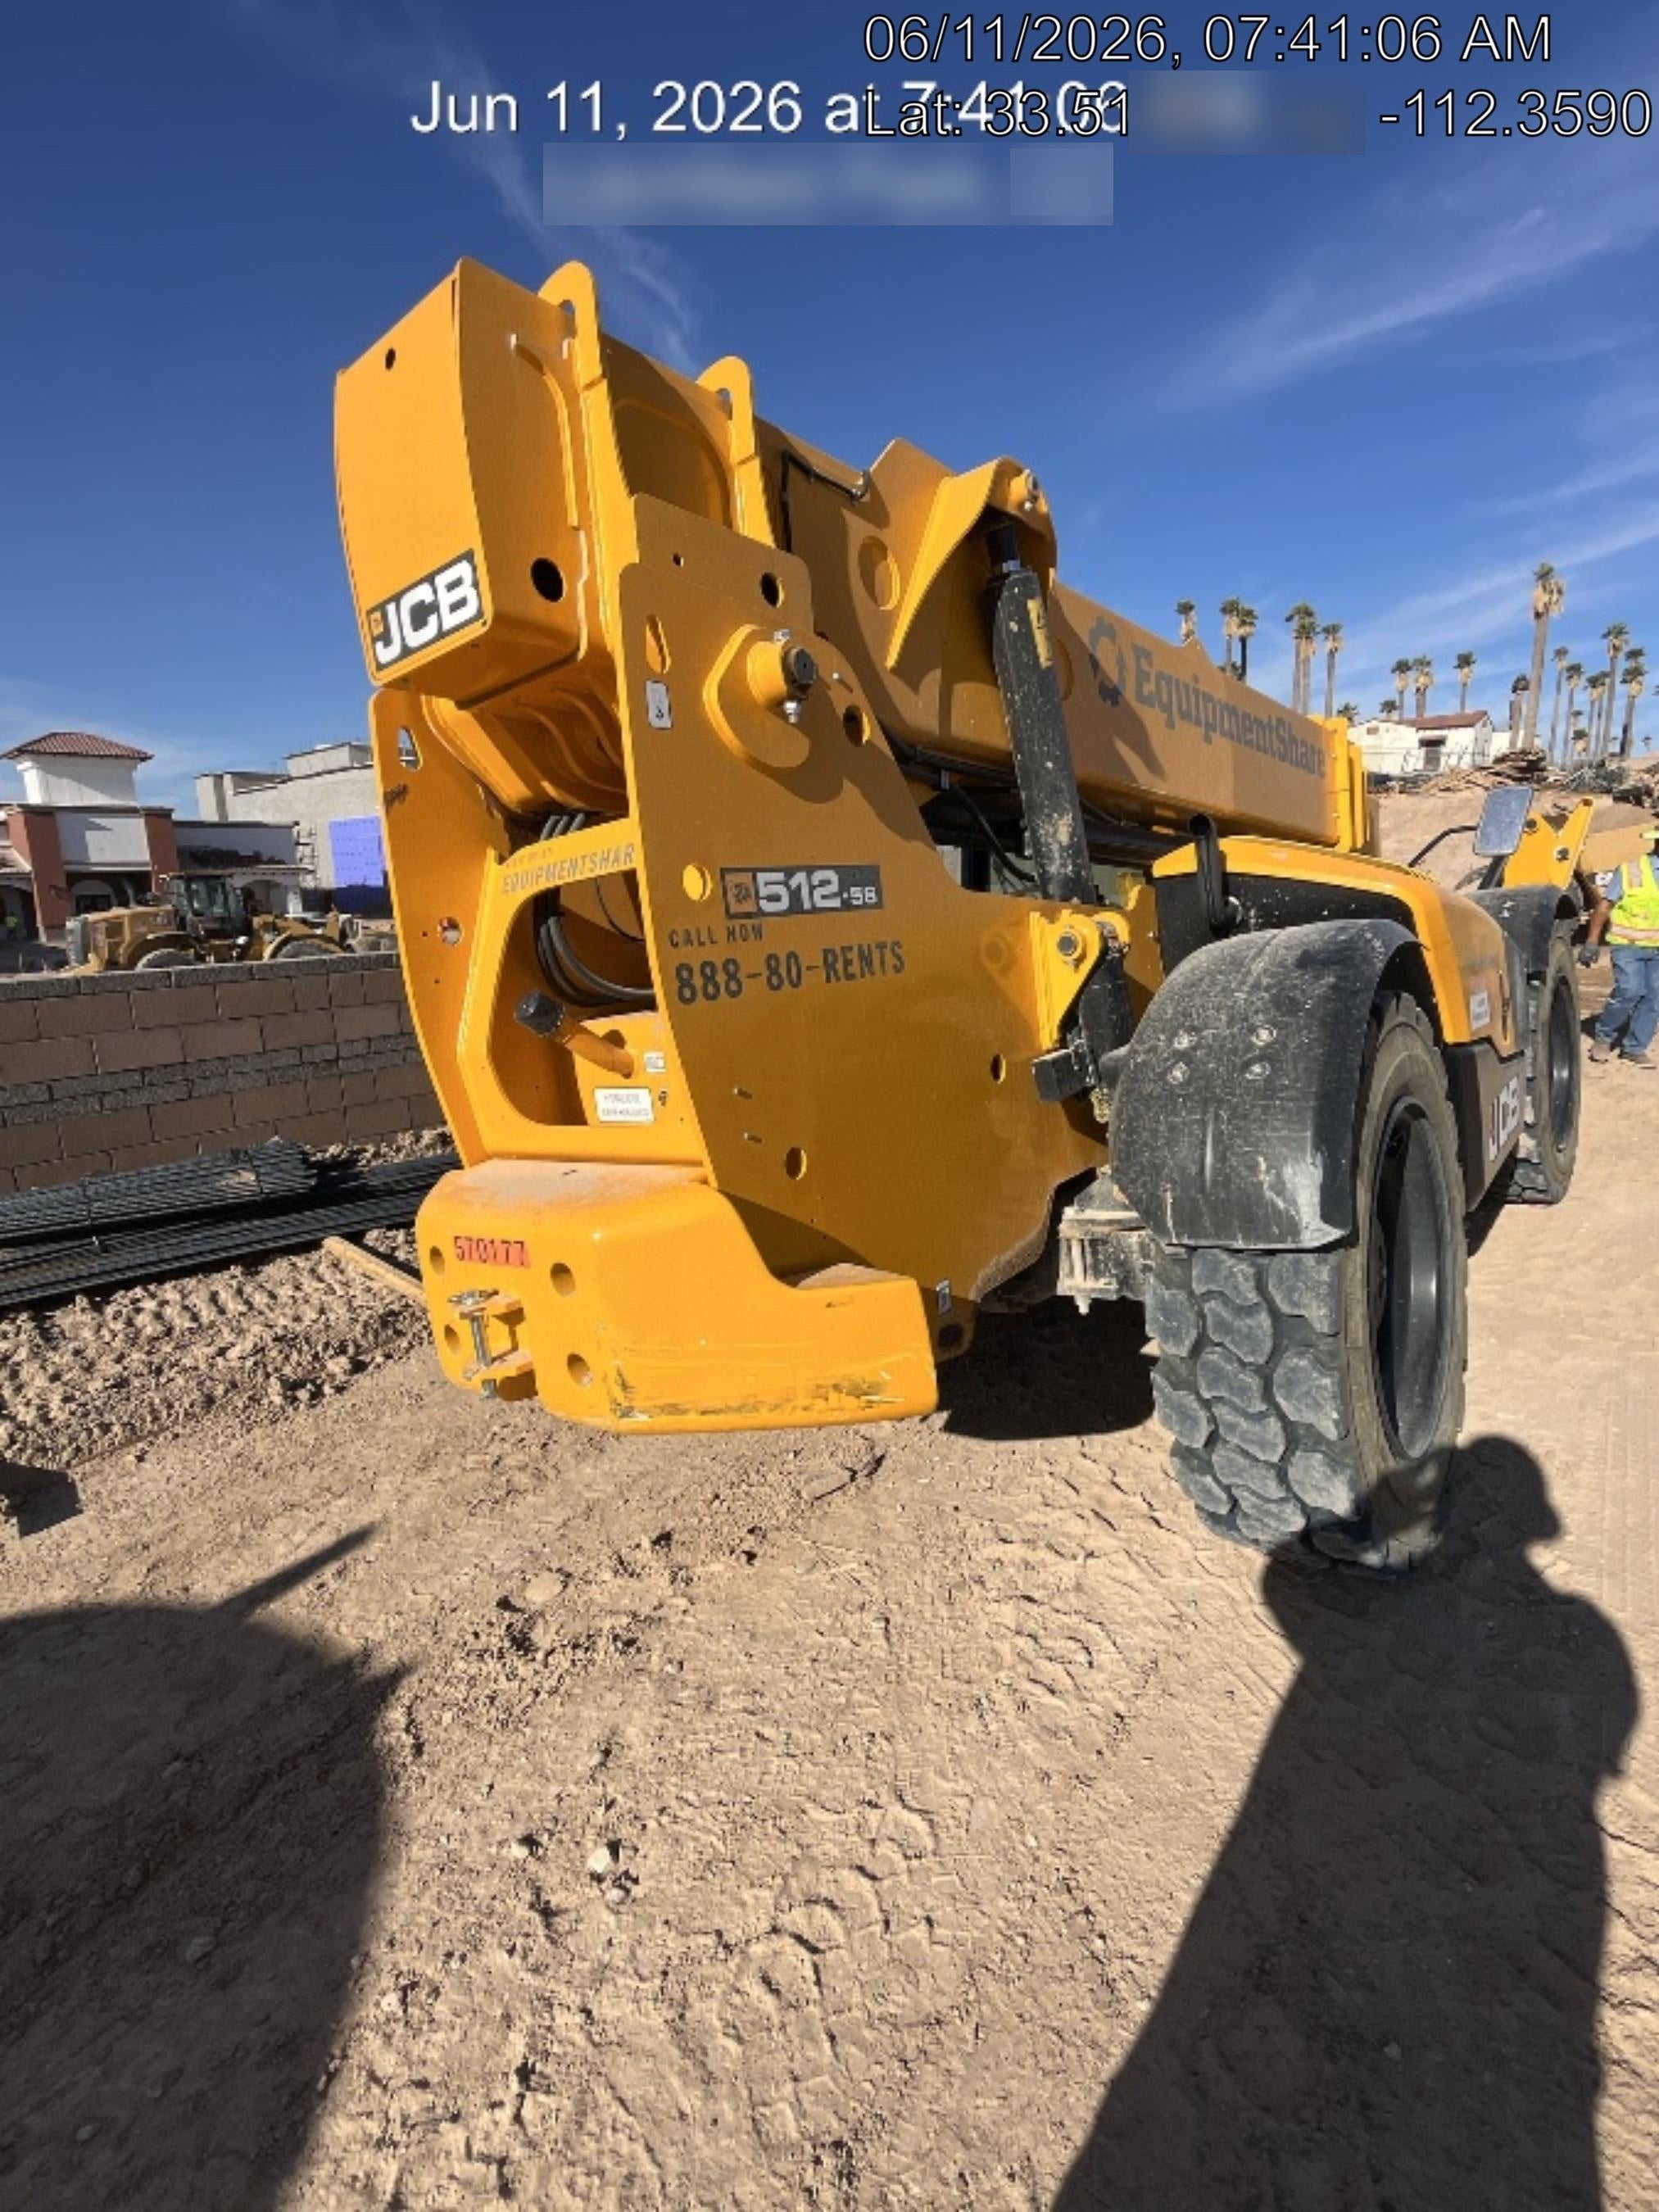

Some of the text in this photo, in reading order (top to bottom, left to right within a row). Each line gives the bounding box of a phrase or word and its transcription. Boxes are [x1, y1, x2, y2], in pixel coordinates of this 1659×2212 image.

[374, 559, 482, 665] JCB
[1131, 642, 1326, 780] EquipmentShare
[502, 842, 636, 895] EQUIPMENTSHAR
[668, 922, 764, 950] CALL NOW
[674, 941, 906, 1006] 888-80-RENTS
